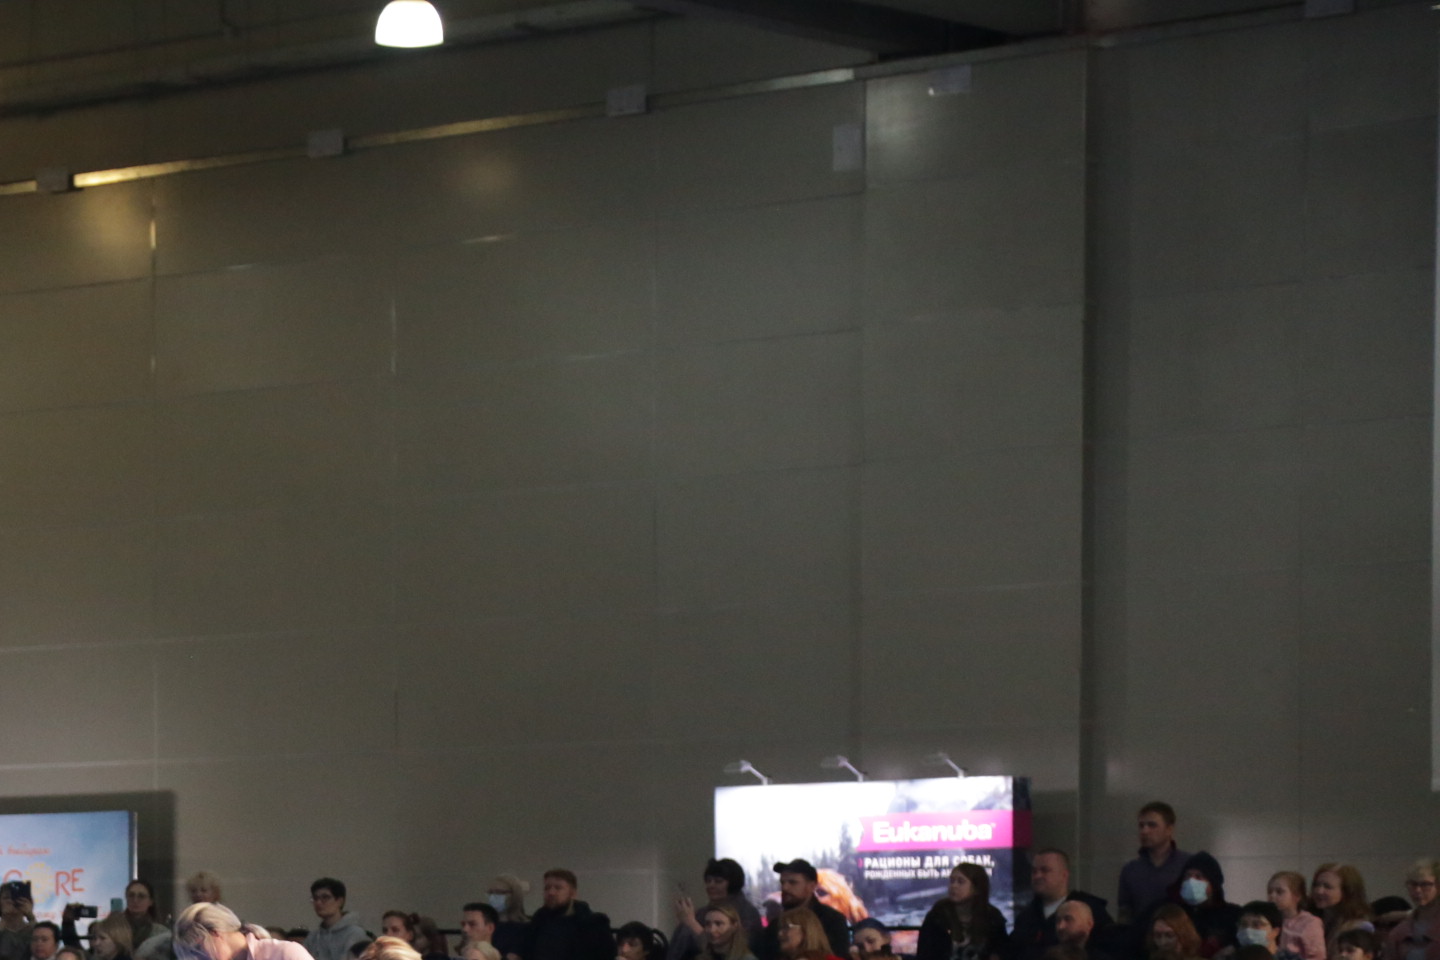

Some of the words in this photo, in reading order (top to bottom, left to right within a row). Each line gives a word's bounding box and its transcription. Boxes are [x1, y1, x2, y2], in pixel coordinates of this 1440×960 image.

[872, 819, 993, 844] Eukanuba
[864, 856, 921, 869] РАЦИОНЫ
[923, 855, 950, 869] ДЛЯ
